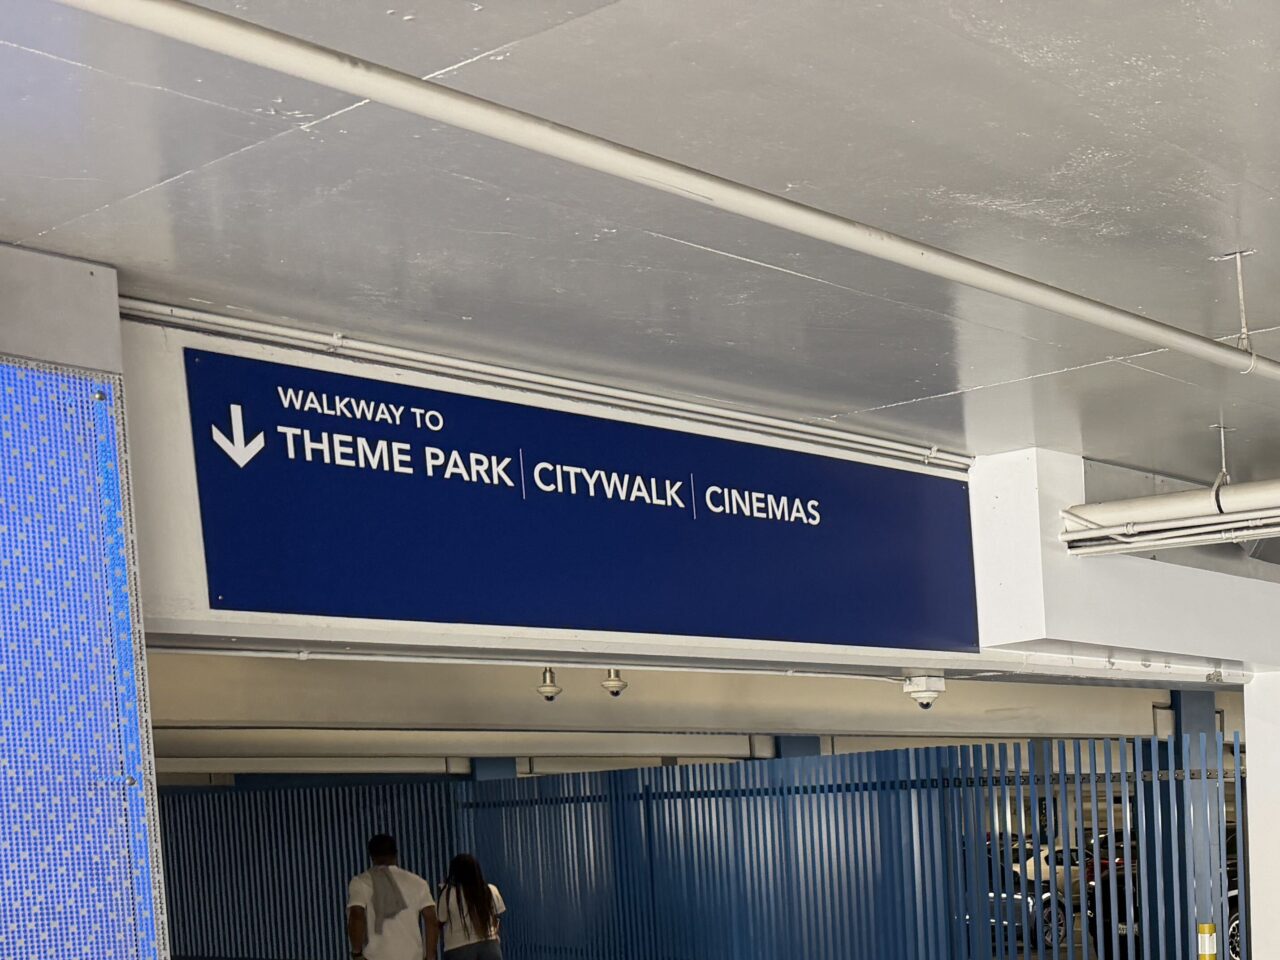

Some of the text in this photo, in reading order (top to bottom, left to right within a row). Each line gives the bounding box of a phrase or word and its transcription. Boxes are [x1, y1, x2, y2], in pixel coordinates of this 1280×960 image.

[277, 386, 444, 431] WALKWAY TO
[276, 425, 821, 526] THEME PARK CITYWALK CINEMAS
